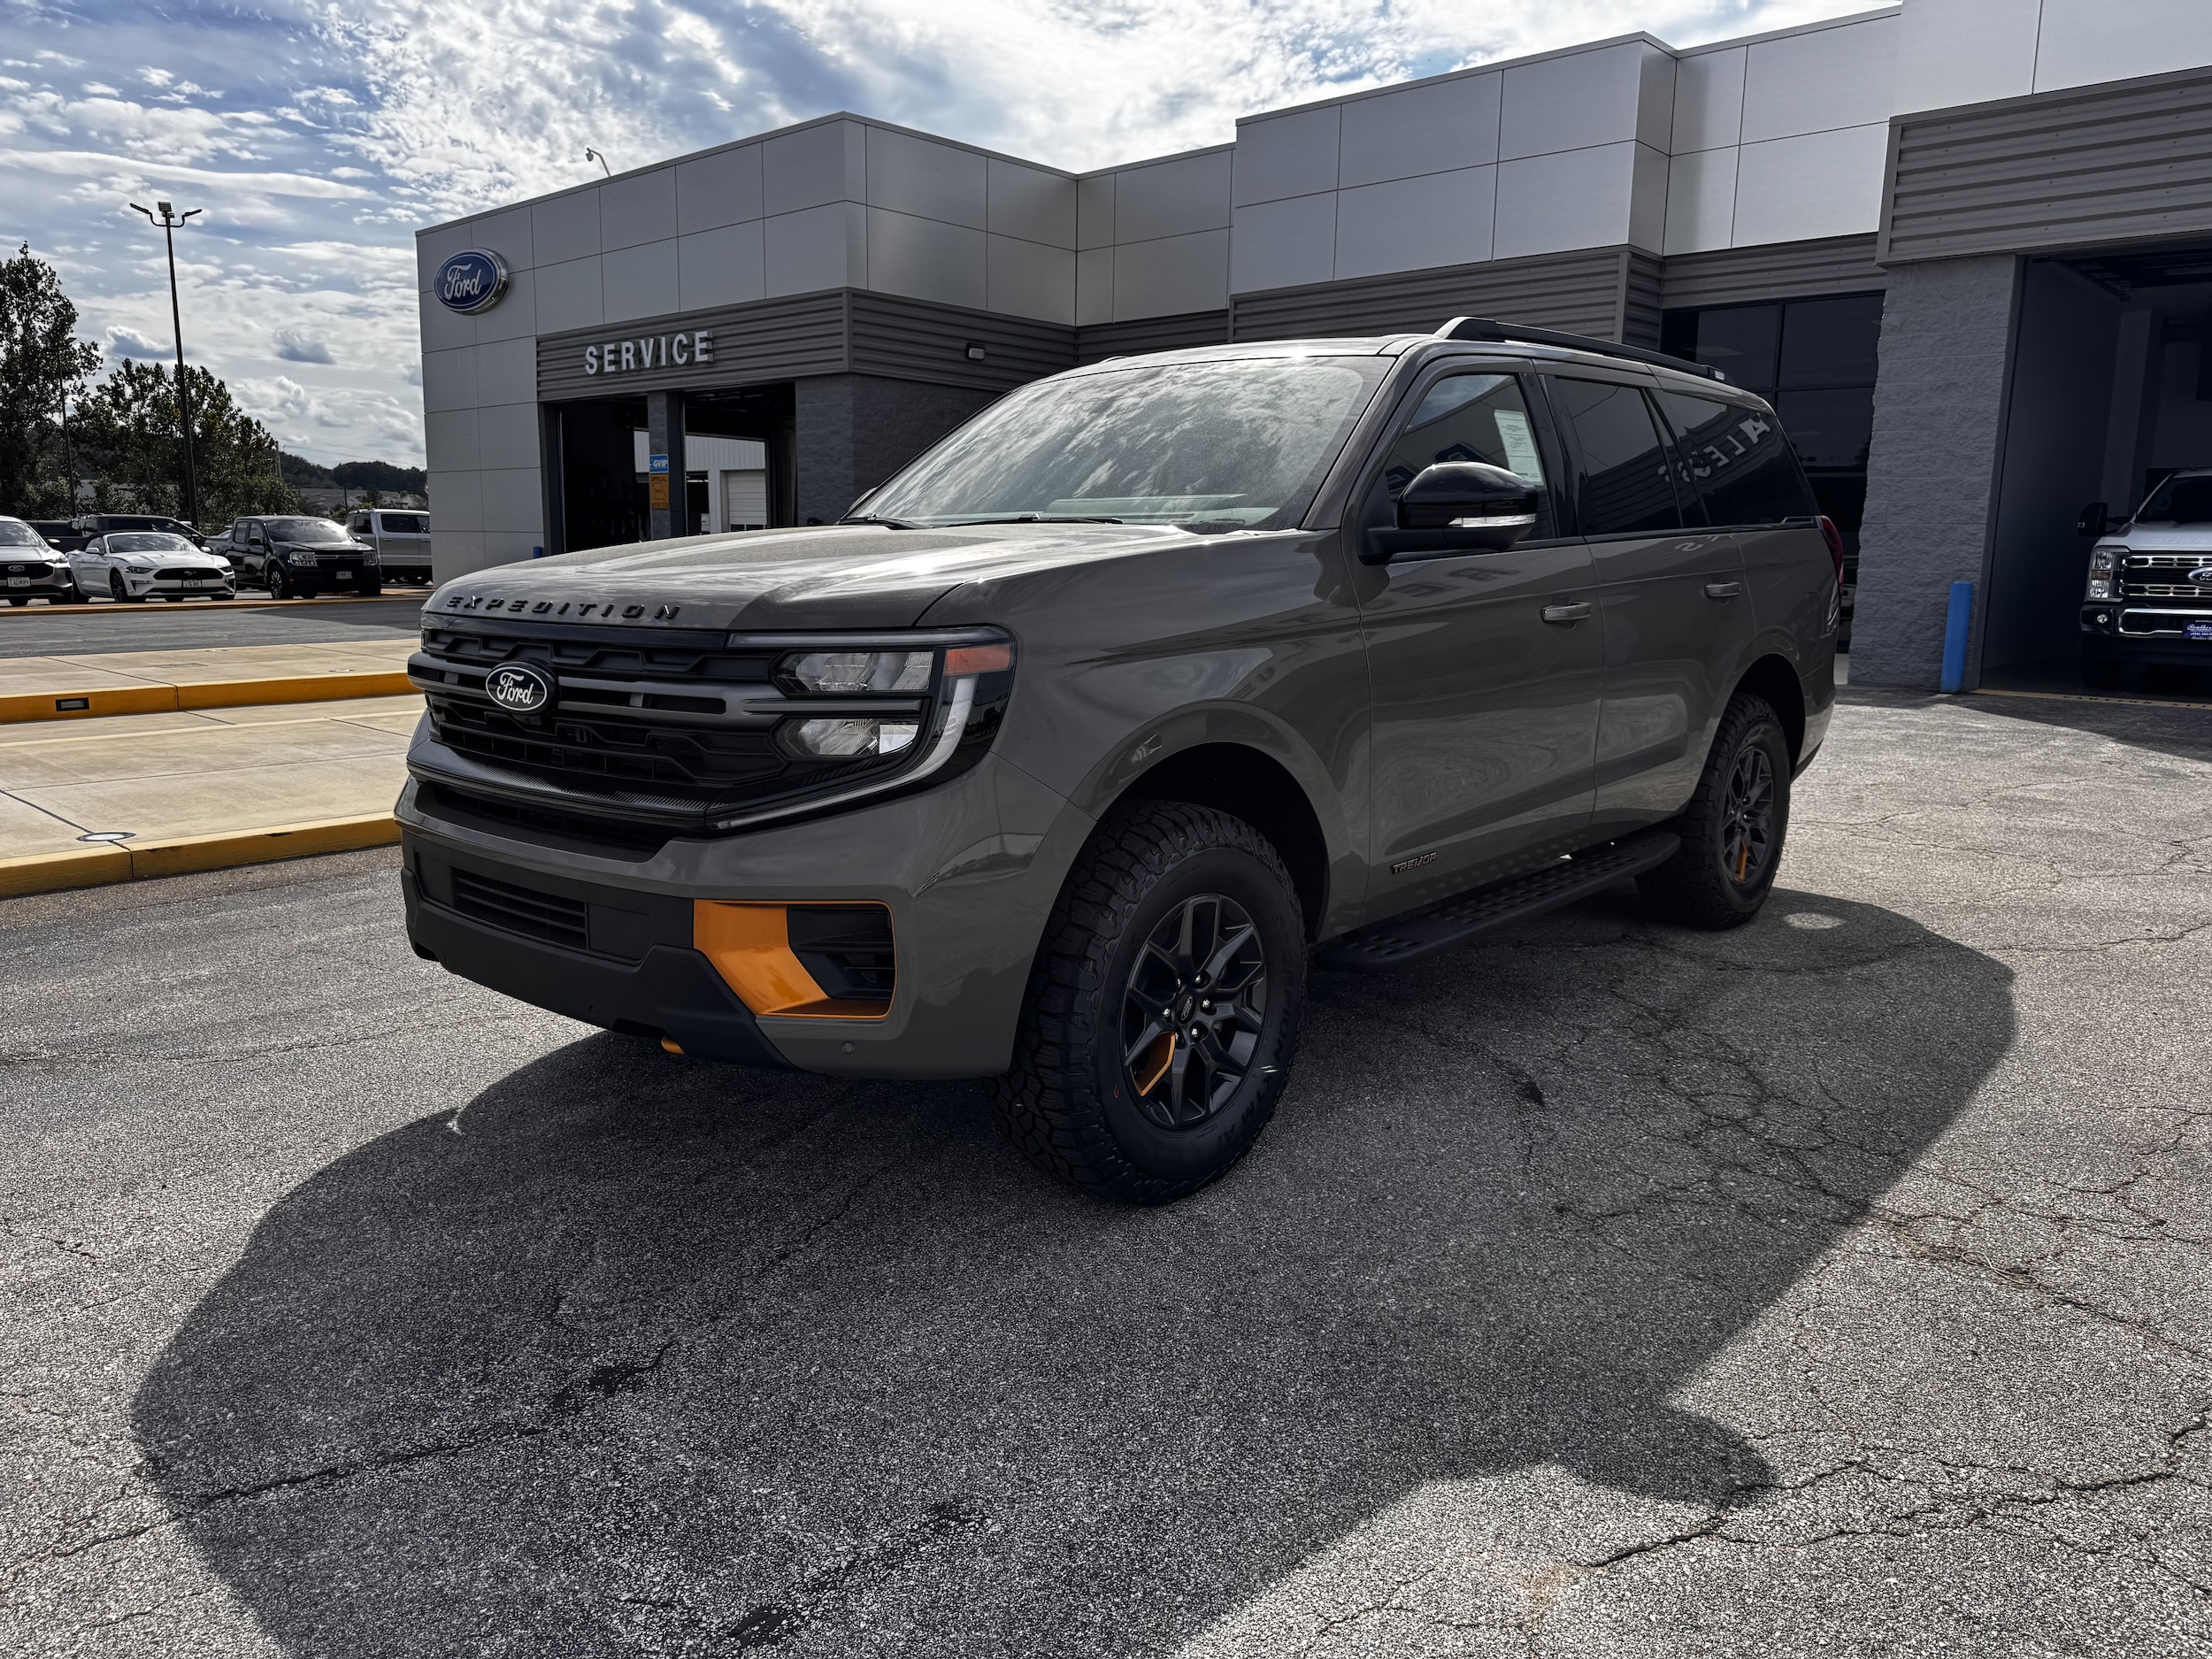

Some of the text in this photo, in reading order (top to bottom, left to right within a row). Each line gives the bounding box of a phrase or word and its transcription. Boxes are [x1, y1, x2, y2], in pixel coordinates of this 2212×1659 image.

[444, 263, 481, 300] Ford
[585, 331, 711, 375] SERVICE
[446, 595, 681, 619] EXPEDITION
[496, 671, 534, 705] Ford
[1392, 851, 1438, 873] TREMOR
